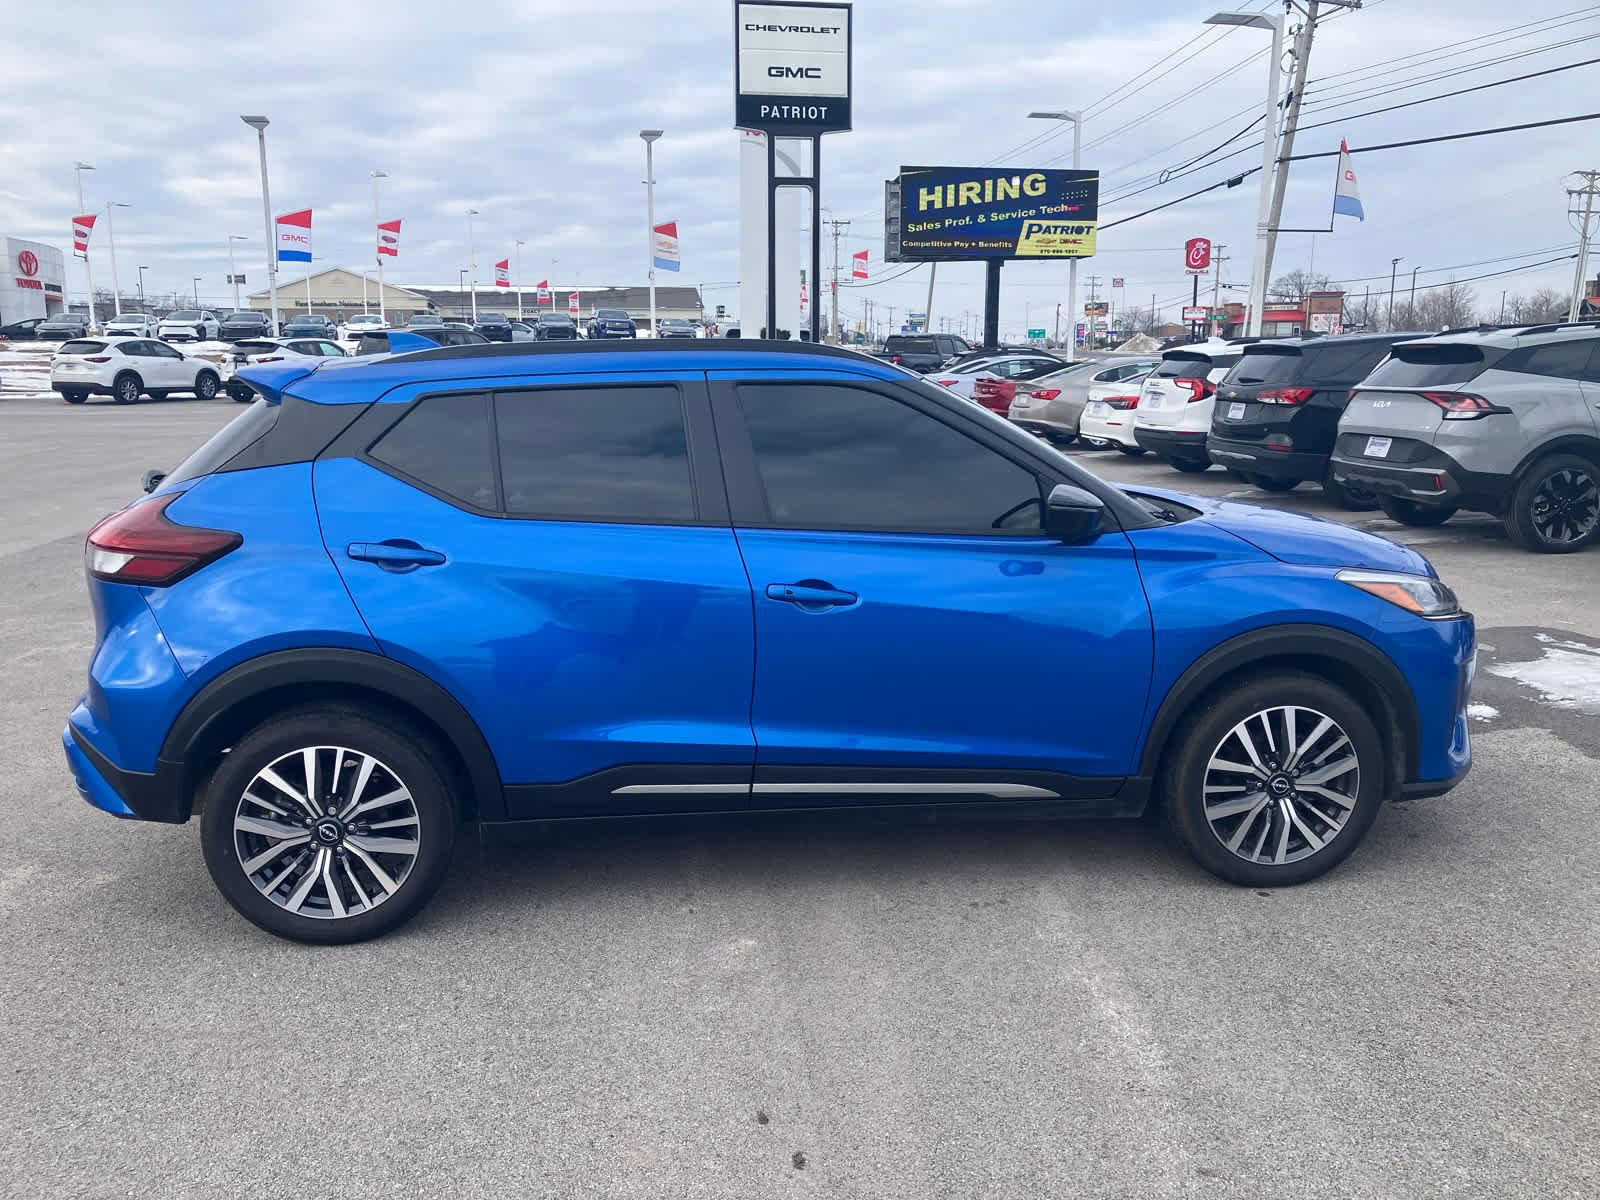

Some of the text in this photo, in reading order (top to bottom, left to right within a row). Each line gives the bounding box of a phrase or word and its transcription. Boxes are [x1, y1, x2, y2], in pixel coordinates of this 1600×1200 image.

[745, 24, 840, 34] CHEVROLET
[768, 66, 822, 78] GMC
[760, 105, 828, 119] PATRIOT
[919, 173, 1047, 211] HIRING
[907, 222, 941, 233] Sales
[945, 216, 973, 228] Prof.
[977, 214, 986, 223] &
[990, 209, 1036, 221] Service
[1025, 223, 1094, 240] PATRIOT
[281, 233, 308, 244] GMC
[902, 240, 952, 249] Competitive
